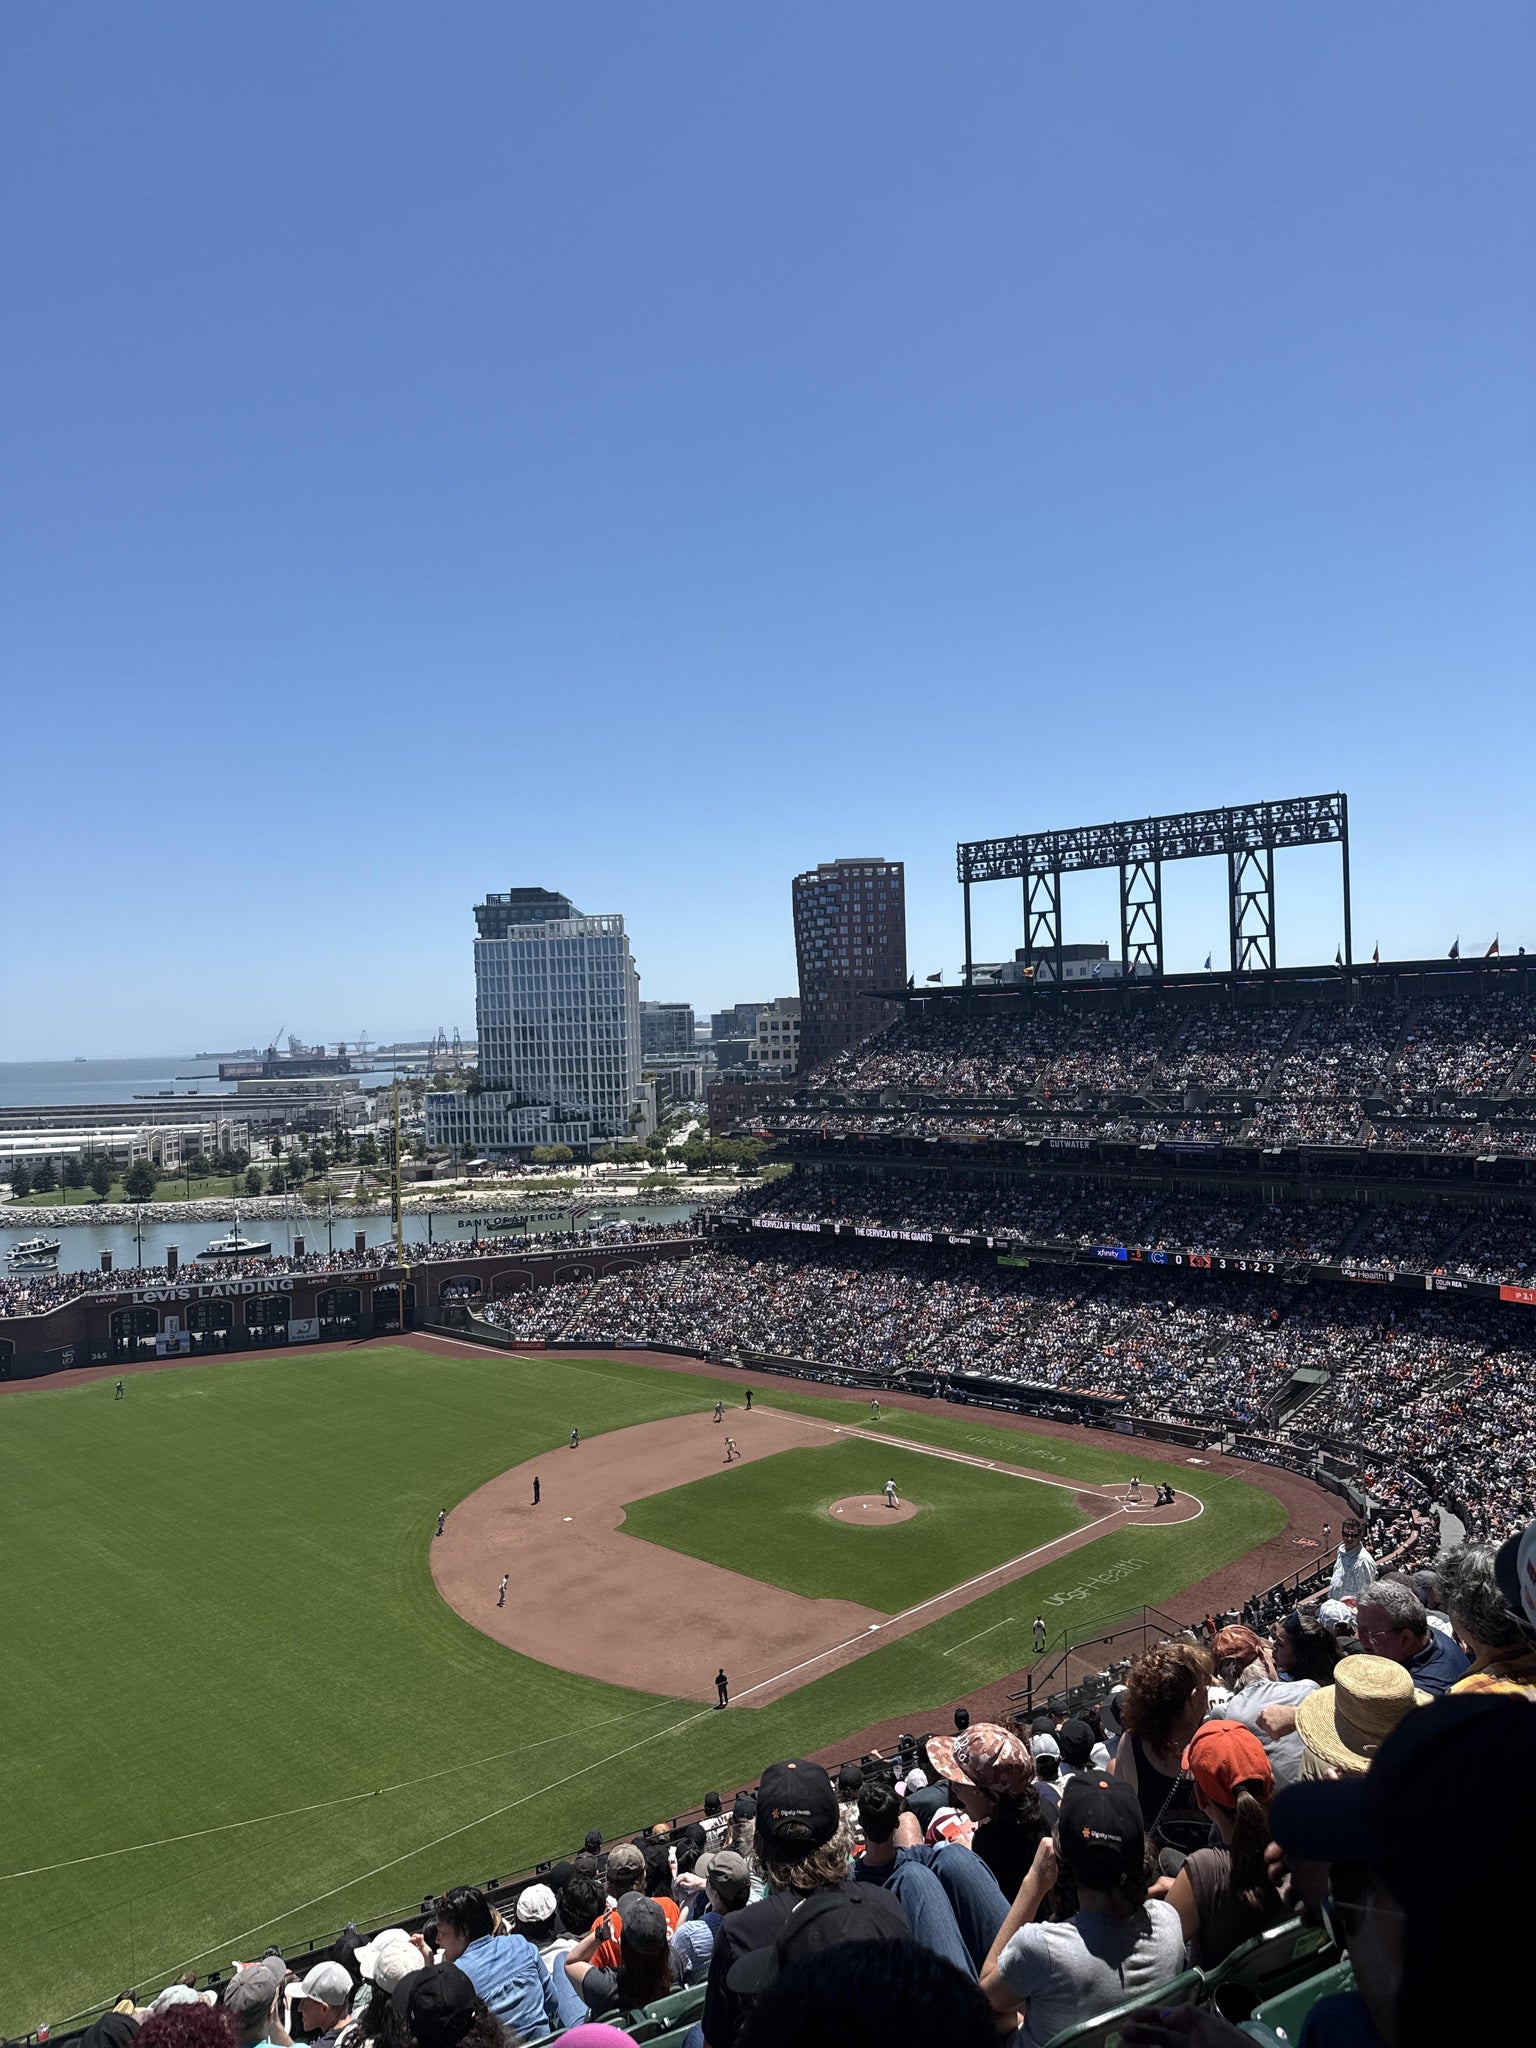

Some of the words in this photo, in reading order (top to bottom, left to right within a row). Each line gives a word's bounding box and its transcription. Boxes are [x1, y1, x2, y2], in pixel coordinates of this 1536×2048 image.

[1050, 1140, 1090, 1149] CUTWATER
[458, 1218, 490, 1228] BANK
[512, 1212, 564, 1223] AMERICA
[752, 1218, 761, 1227] THE
[761, 1220, 783, 1229] CERVEZA
[784, 1221, 790, 1229] OF
[791, 1222, 801, 1231] THE
[801, 1223, 821, 1232] GIANTS
[854, 1227, 865, 1236] THE
[866, 1228, 891, 1238] CERVEZA
[891, 1230, 898, 1238] OF
[900, 1231, 911, 1240] THE
[911, 1232, 933, 1242] GIANTS
[948, 1235, 971, 1245] Corona
[1097, 1249, 1119, 1258] xfinity
[1175, 1255, 1183, 1265] 0
[1219, 1259, 1227, 1269] 3
[1239, 1261, 1246, 1271] 3
[1253, 1262, 1260, 1272] 2
[1267, 1263, 1275, 1273] 2
[1357, 1270, 1384, 1280] Health
[199, 1280, 294, 1298] LANDING
[1451, 1280, 1462, 1289] REA
[1522, 1292, 1533, 1301] 3.1
[385, 1321, 400, 1330] 309
[90, 1352, 108, 1360] 365
[1077, 1558, 1150, 1591] Health
